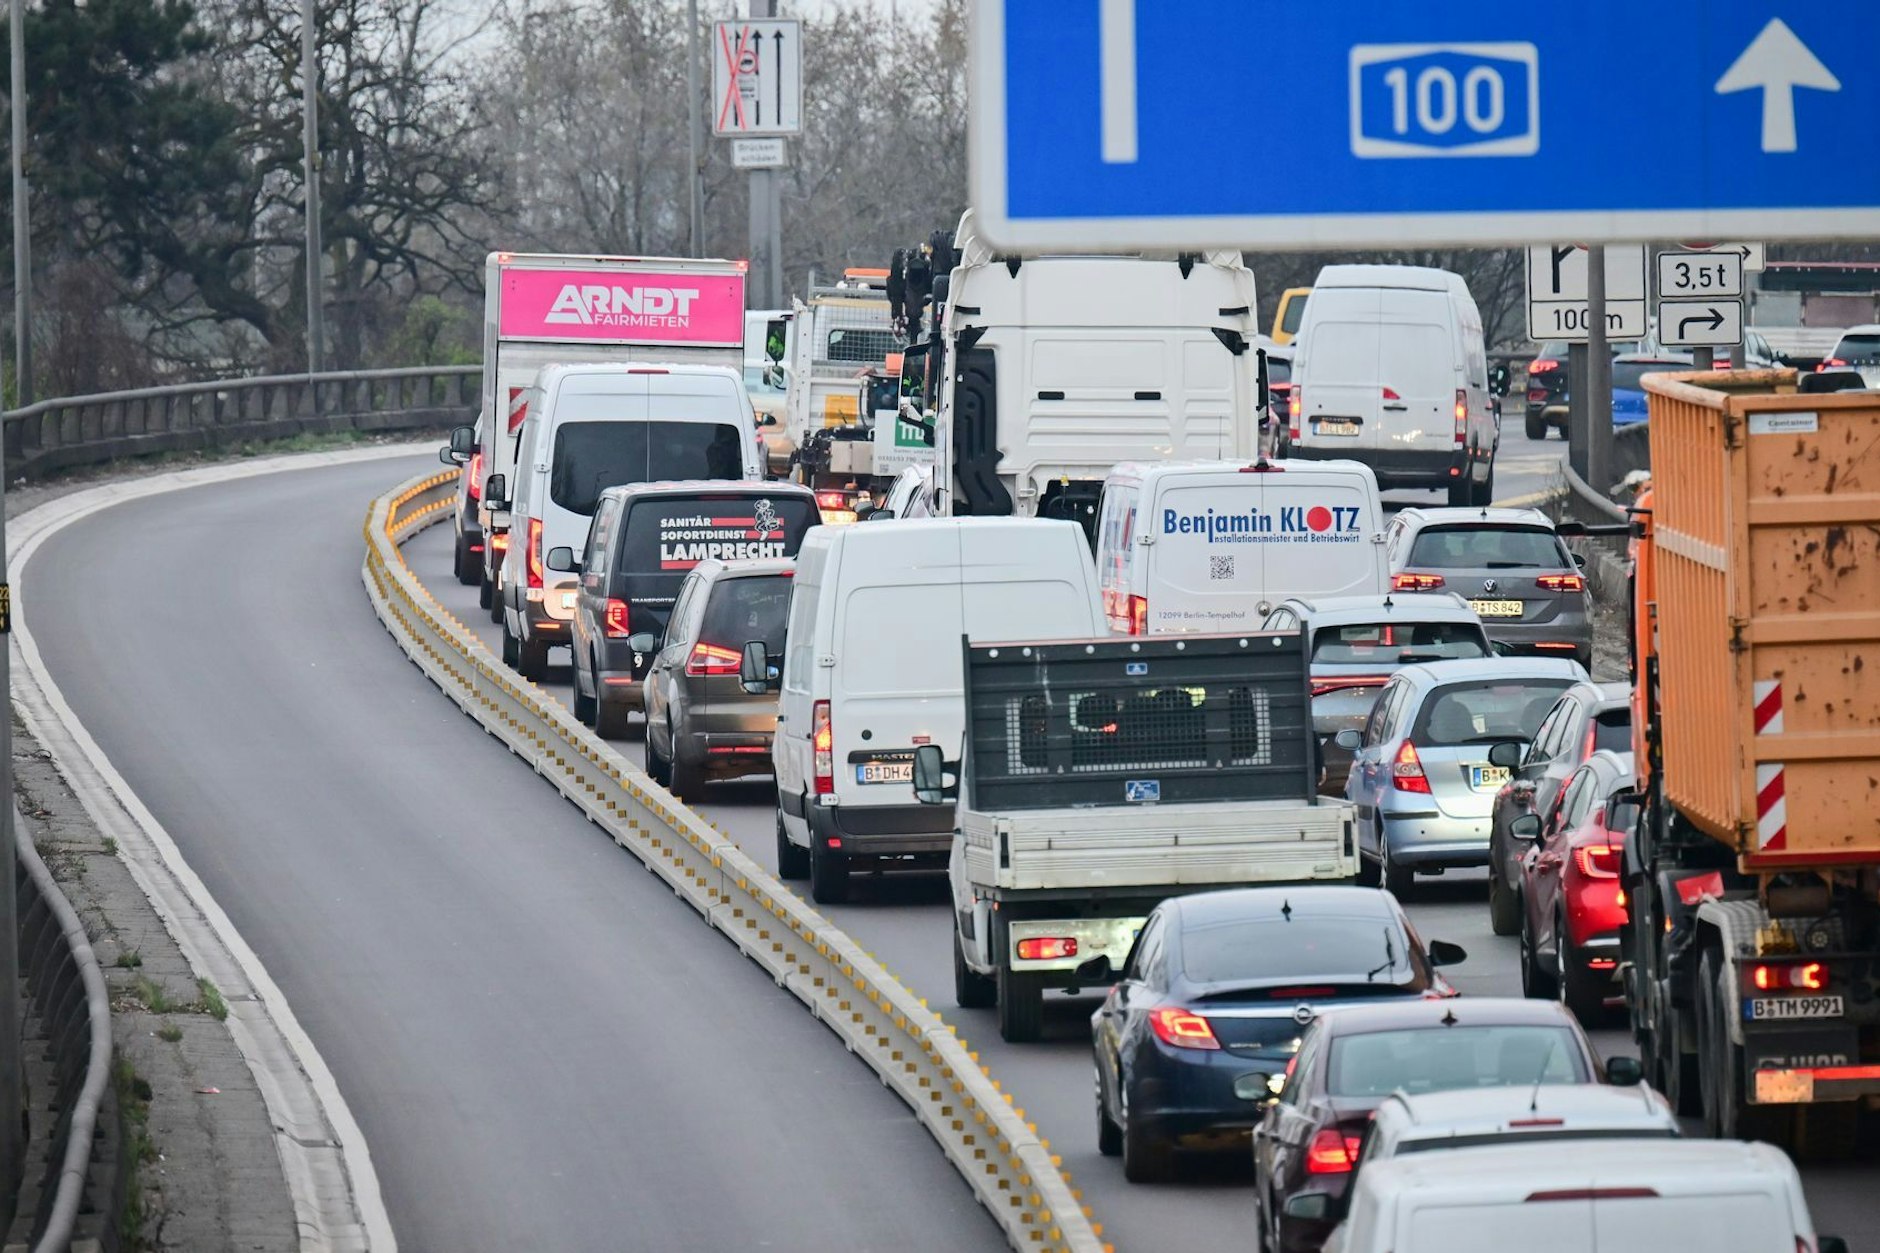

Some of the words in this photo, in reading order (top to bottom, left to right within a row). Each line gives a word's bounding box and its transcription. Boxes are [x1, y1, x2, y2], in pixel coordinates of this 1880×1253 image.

[1384, 65, 1505, 135] 100
[1675, 262, 1712, 290] 3,5
[1717, 264, 1726, 287] t
[544, 284, 699, 324] ARNDT
[594, 313, 690, 328] FAIRMIETEN
[660, 515, 712, 528] SANITÄR
[1164, 508, 1272, 543] Benjamin
[660, 529, 747, 541] SOFORTDIENST
[1293, 533, 1309, 543] und
[1311, 532, 1360, 543] Betriebswirt
[661, 542, 786, 561] LAMPRECHT
[1501, 602, 1520, 612] 842
[865, 768, 873, 780] B
[883, 767, 900, 779] DH
[1482, 770, 1490, 781] B
[1755, 1001, 1764, 1016] B
[1776, 1000, 1797, 1015] TM
[1801, 998, 1841, 1014] 9991
